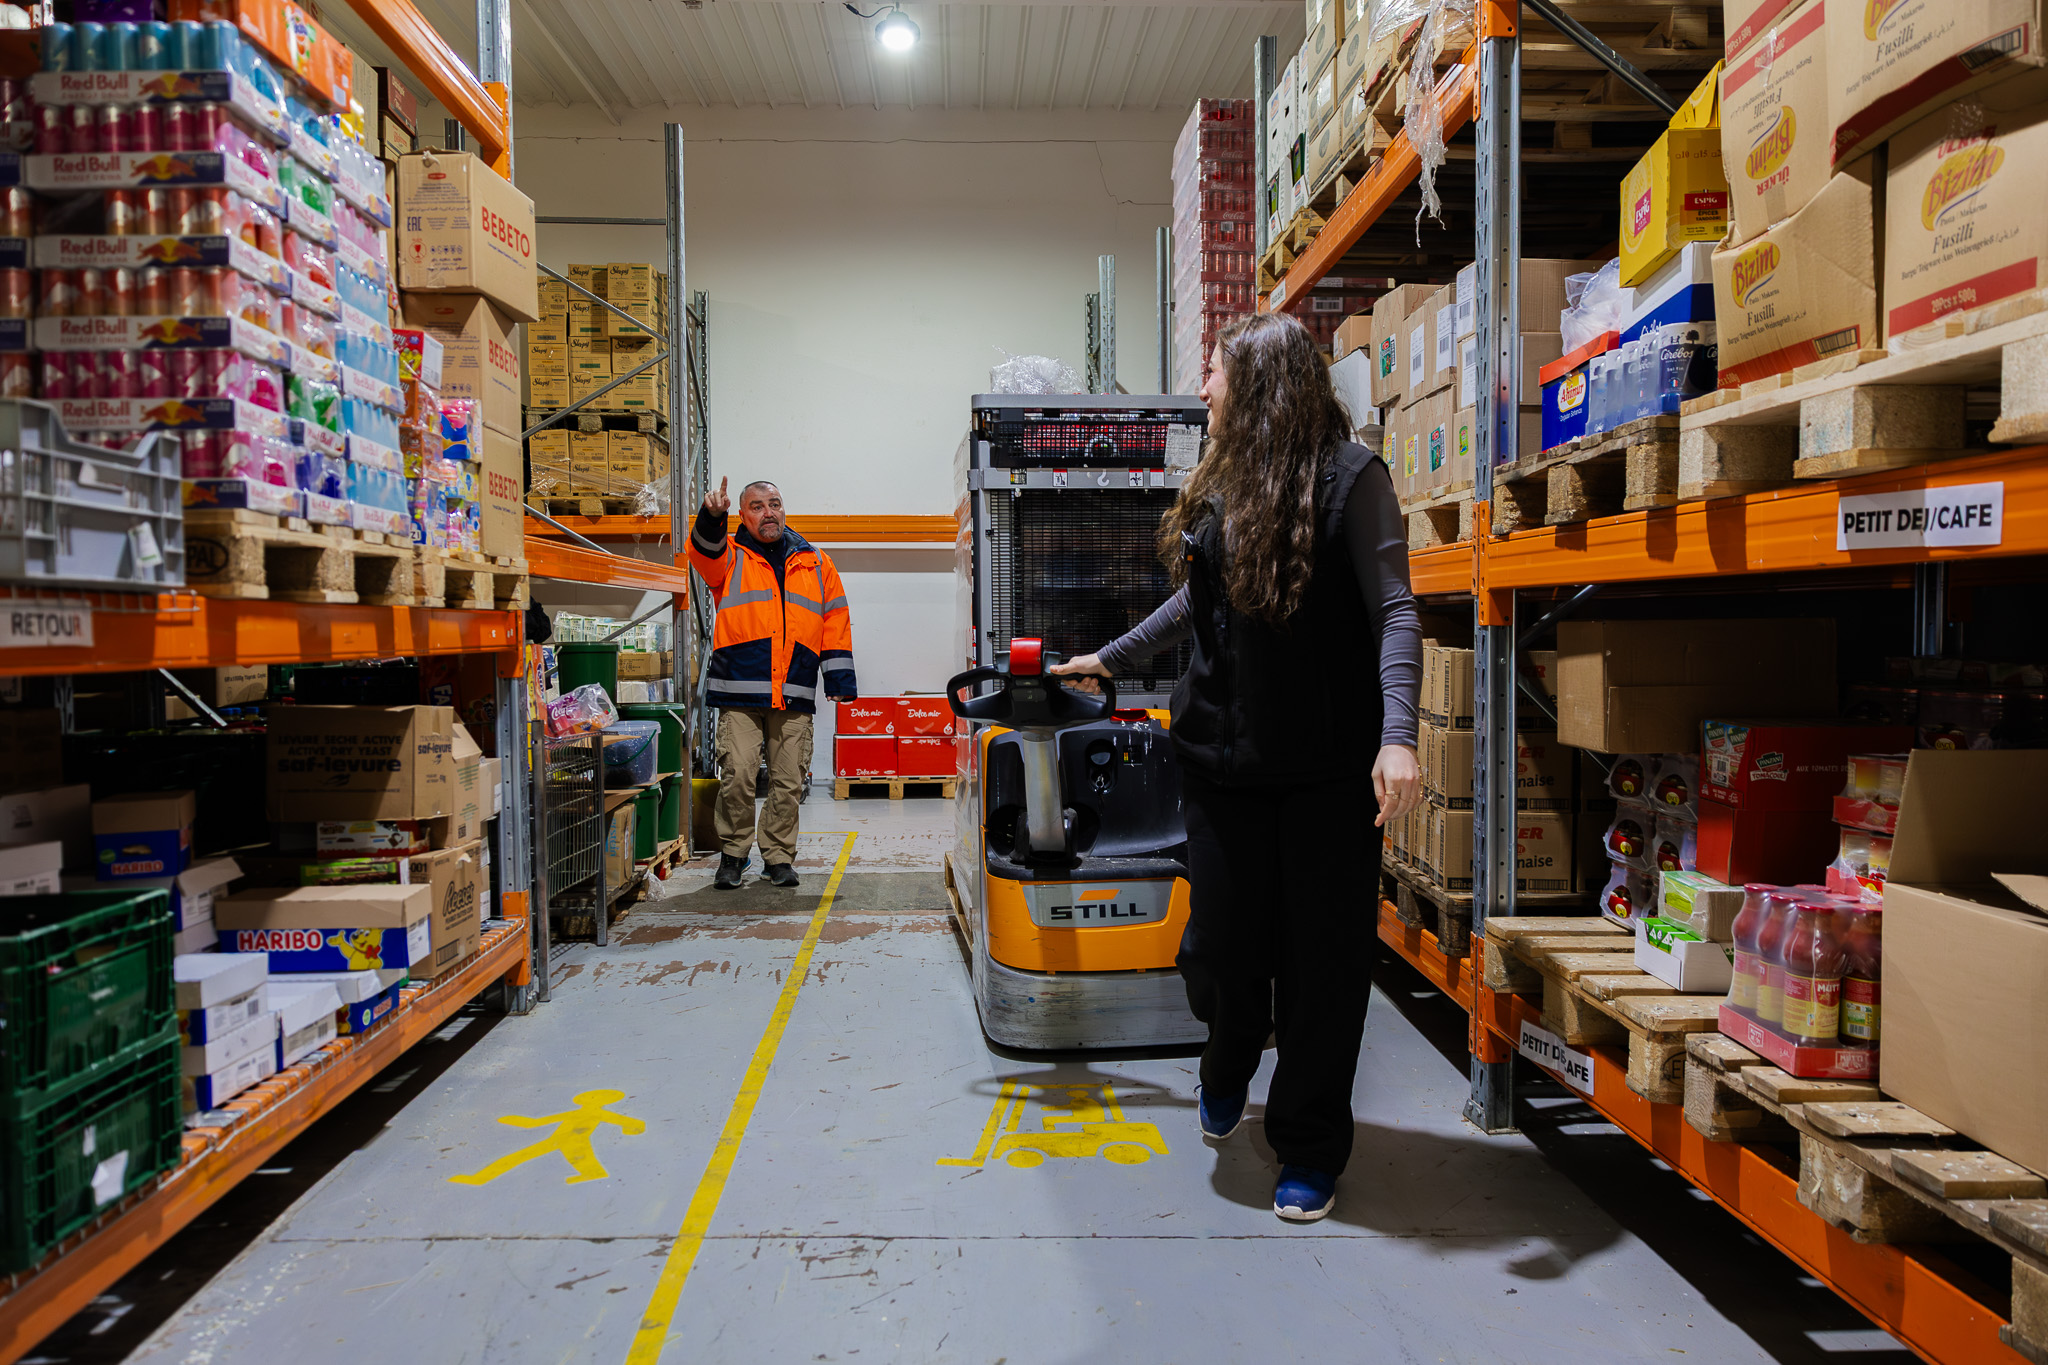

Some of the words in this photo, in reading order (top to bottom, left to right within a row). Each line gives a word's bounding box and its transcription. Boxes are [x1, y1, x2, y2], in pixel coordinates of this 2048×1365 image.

[1875, 22, 1915, 63] Fusilli
[61, 74, 94, 90] Red
[97, 73, 129, 90] Bull
[1754, 87, 1782, 119] Fusilli
[1749, 117, 1792, 177] Bizim
[53, 156, 86, 173] Red
[89, 155, 121, 172] Bull
[1756, 165, 1790, 196] ÜLKER
[1927, 148, 1998, 217] Bizim
[482, 206, 530, 258] BEBETO
[1932, 221, 1975, 254] Fusilli
[60, 238, 94, 254] Red
[97, 238, 128, 254] Bull
[1733, 244, 1775, 297] Bizim
[61, 318, 93, 335] Red
[96, 318, 128, 334] Bull
[1747, 303, 1775, 327] Fusilli
[489, 339, 518, 379] BEBETO
[1660, 347, 1693, 361] Cérébos
[62, 401, 95, 417] Red
[99, 400, 131, 417] Bull
[489, 471, 518, 503] BEBETO
[1844, 510, 1893, 534] PETIT
[1897, 503, 1993, 532] DEJ/CAFE
[12, 612, 83, 637] RETOUR
[850, 708, 870, 718] Dolce
[907, 709, 927, 719] Dolce
[278, 735, 320, 745] LEVURE
[324, 735, 358, 745] SECHE
[363, 735, 402, 745] ACTIVE
[288, 747, 326, 757] ACTIVE
[330, 747, 352, 756] DRY
[358, 746, 392, 756] YEAST
[417, 743, 452, 755] saf-levure
[277, 757, 402, 773] saf-levure
[1759, 755, 1783, 767] PANZANI
[111, 860, 165, 875] HARIBO
[1050, 902, 1148, 920] STILL
[237, 929, 323, 952] HARIBO
[372, 996, 393, 1020] HARIBO
[1522, 1031, 1549, 1057] PETIT
